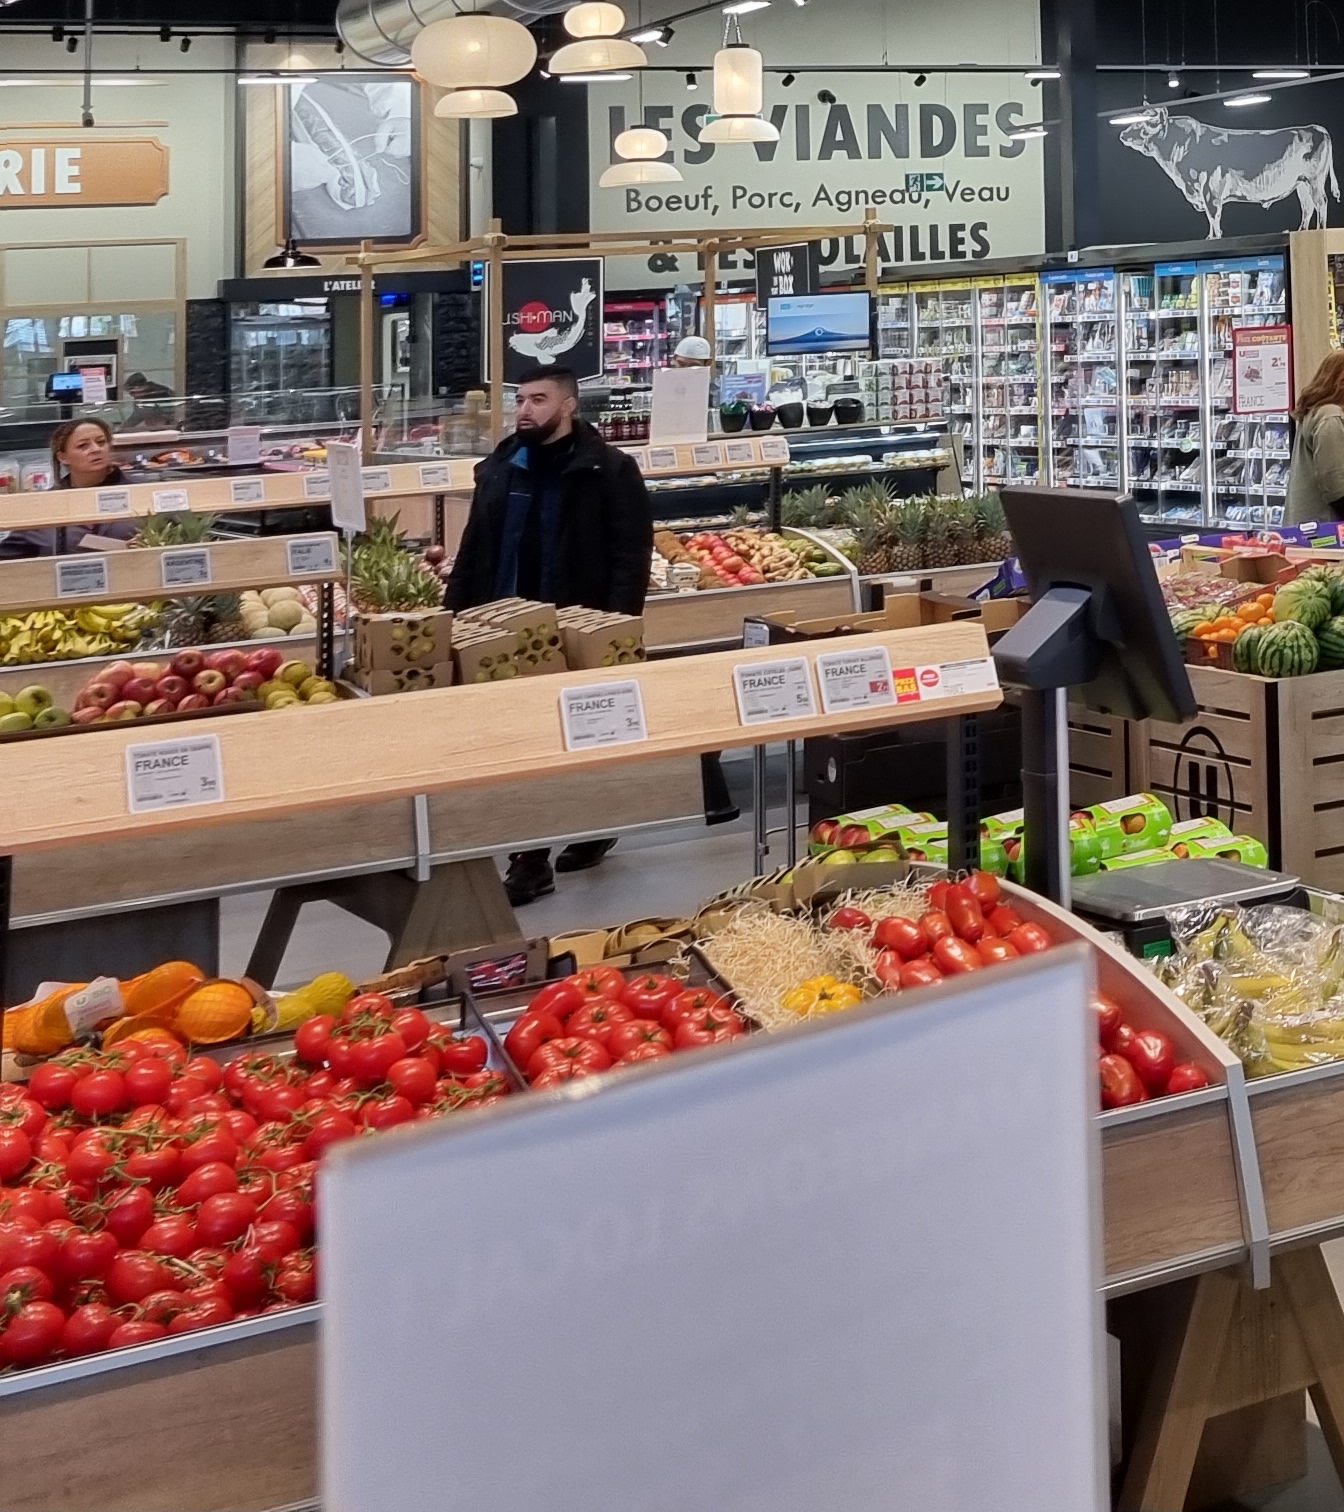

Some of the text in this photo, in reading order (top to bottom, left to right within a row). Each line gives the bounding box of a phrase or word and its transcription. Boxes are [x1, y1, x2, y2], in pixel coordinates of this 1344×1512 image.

[752, 101, 1027, 163] VIANDES
[625, 187, 720, 217] Boeuf,
[731, 184, 802, 213] Porc,
[943, 179, 1011, 203] Veau
[824, 663, 868, 679] FRANCE
[742, 674, 786, 690] FRANCE
[568, 697, 616, 714] FRANCE
[134, 754, 190, 772] FRANCE
